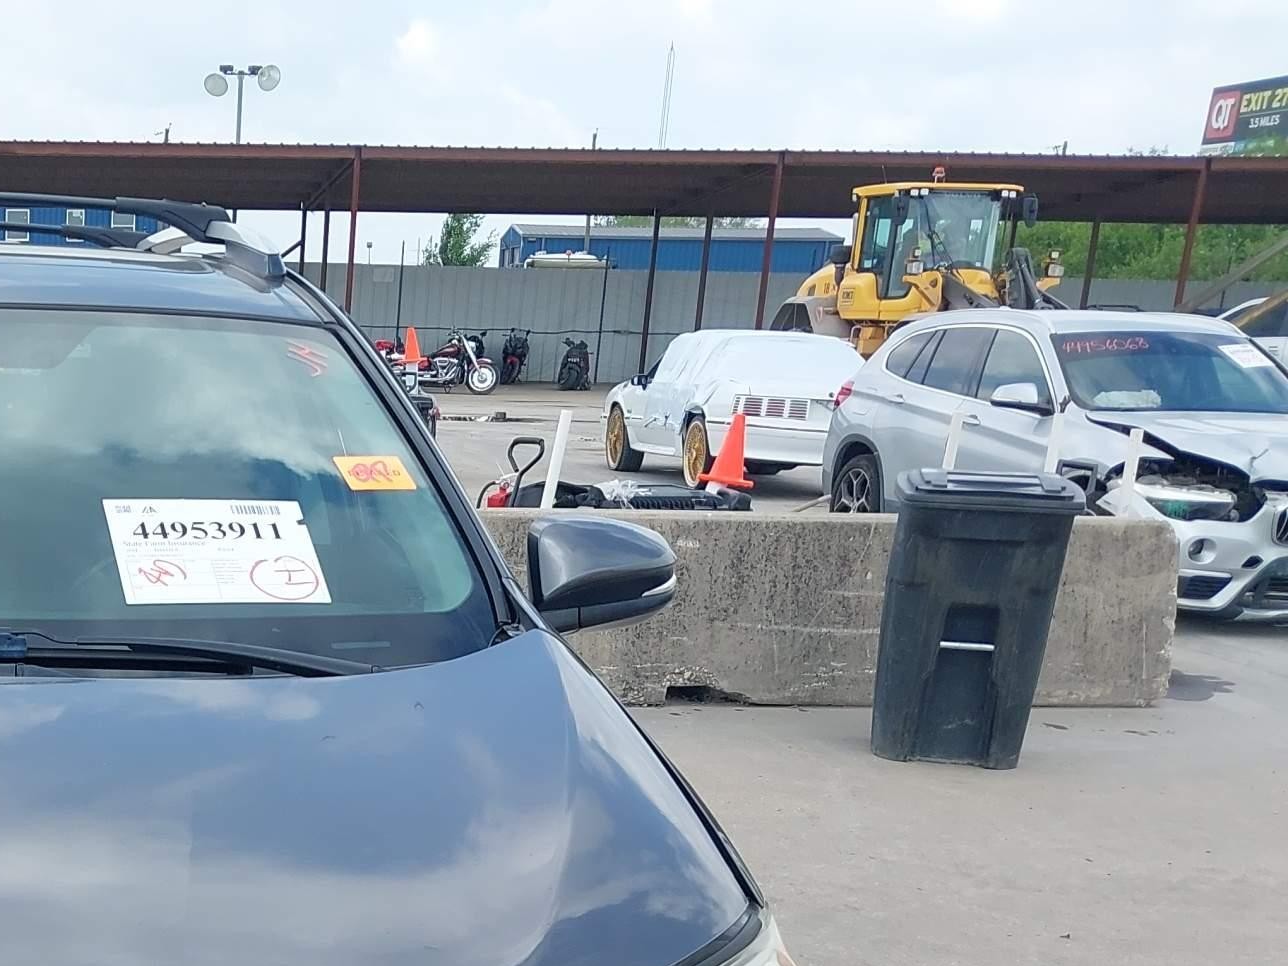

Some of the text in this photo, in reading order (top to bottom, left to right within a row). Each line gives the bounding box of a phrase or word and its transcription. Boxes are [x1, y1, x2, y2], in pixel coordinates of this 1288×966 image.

[1240, 90, 1272, 112] EXIT
[1212, 98, 1235, 130] QT
[1260, 115, 1280, 127] MILES
[132, 521, 283, 540] 44953911
